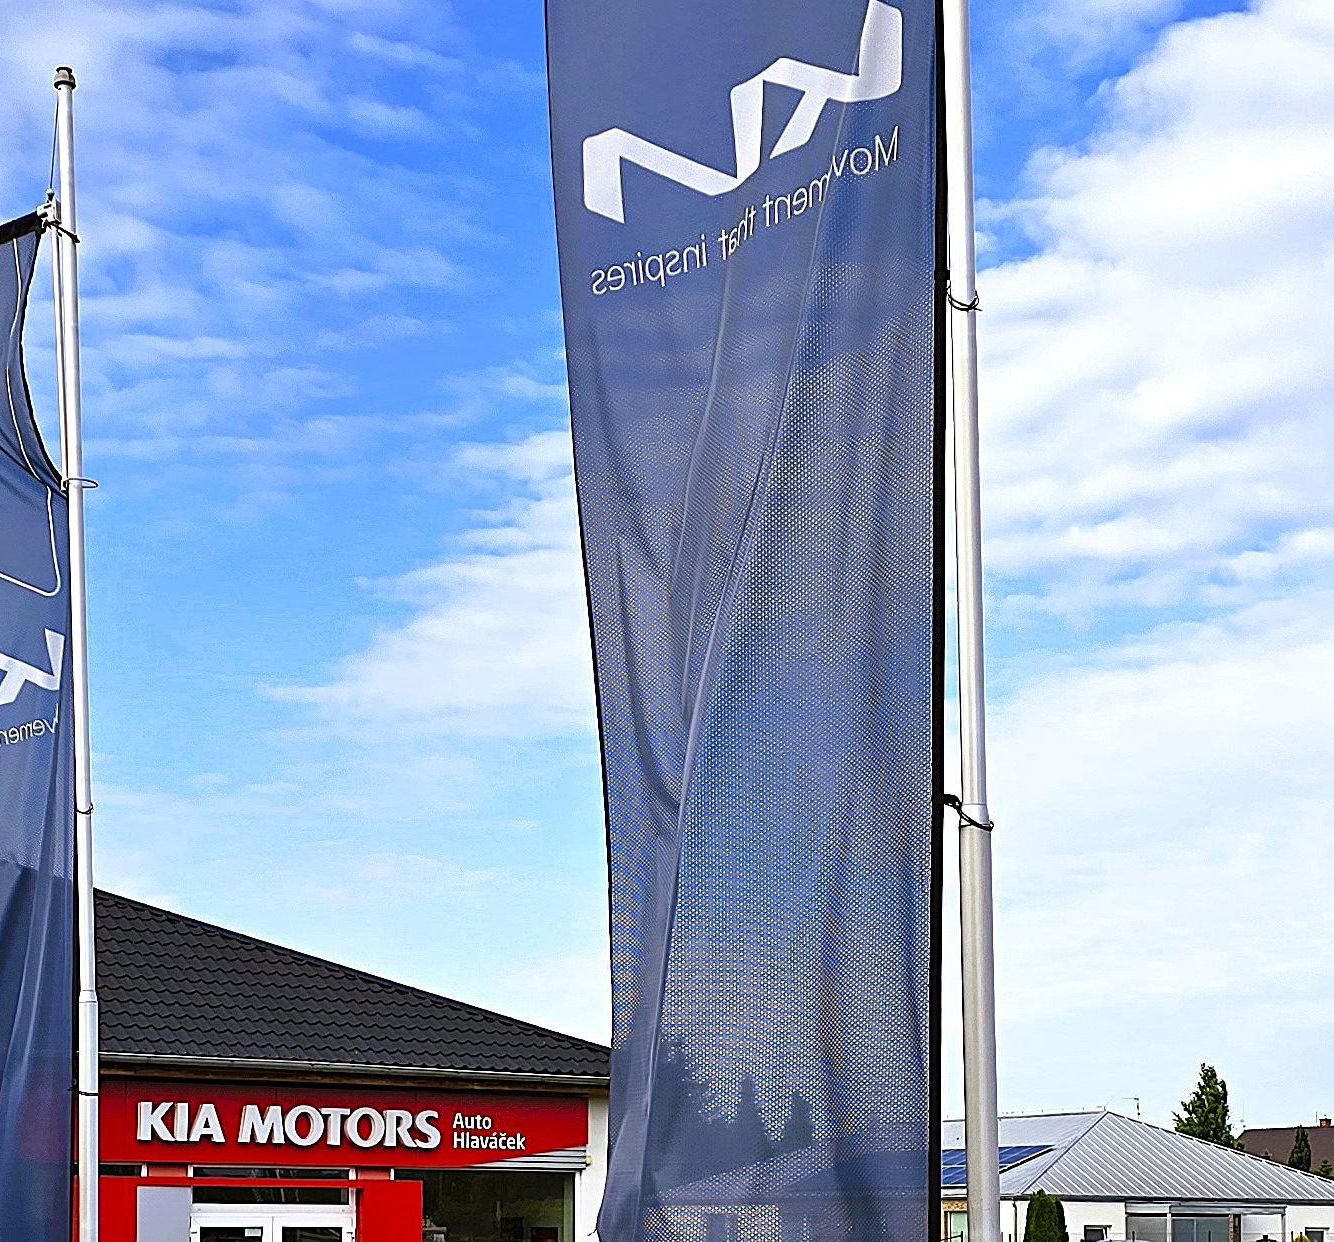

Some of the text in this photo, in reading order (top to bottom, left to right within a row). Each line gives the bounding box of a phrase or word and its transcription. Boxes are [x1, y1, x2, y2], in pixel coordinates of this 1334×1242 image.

[137, 1101, 441, 1149] KIA MOTORS
[453, 1112, 492, 1129] Auto
[453, 1131, 526, 1150] Hlaváček
